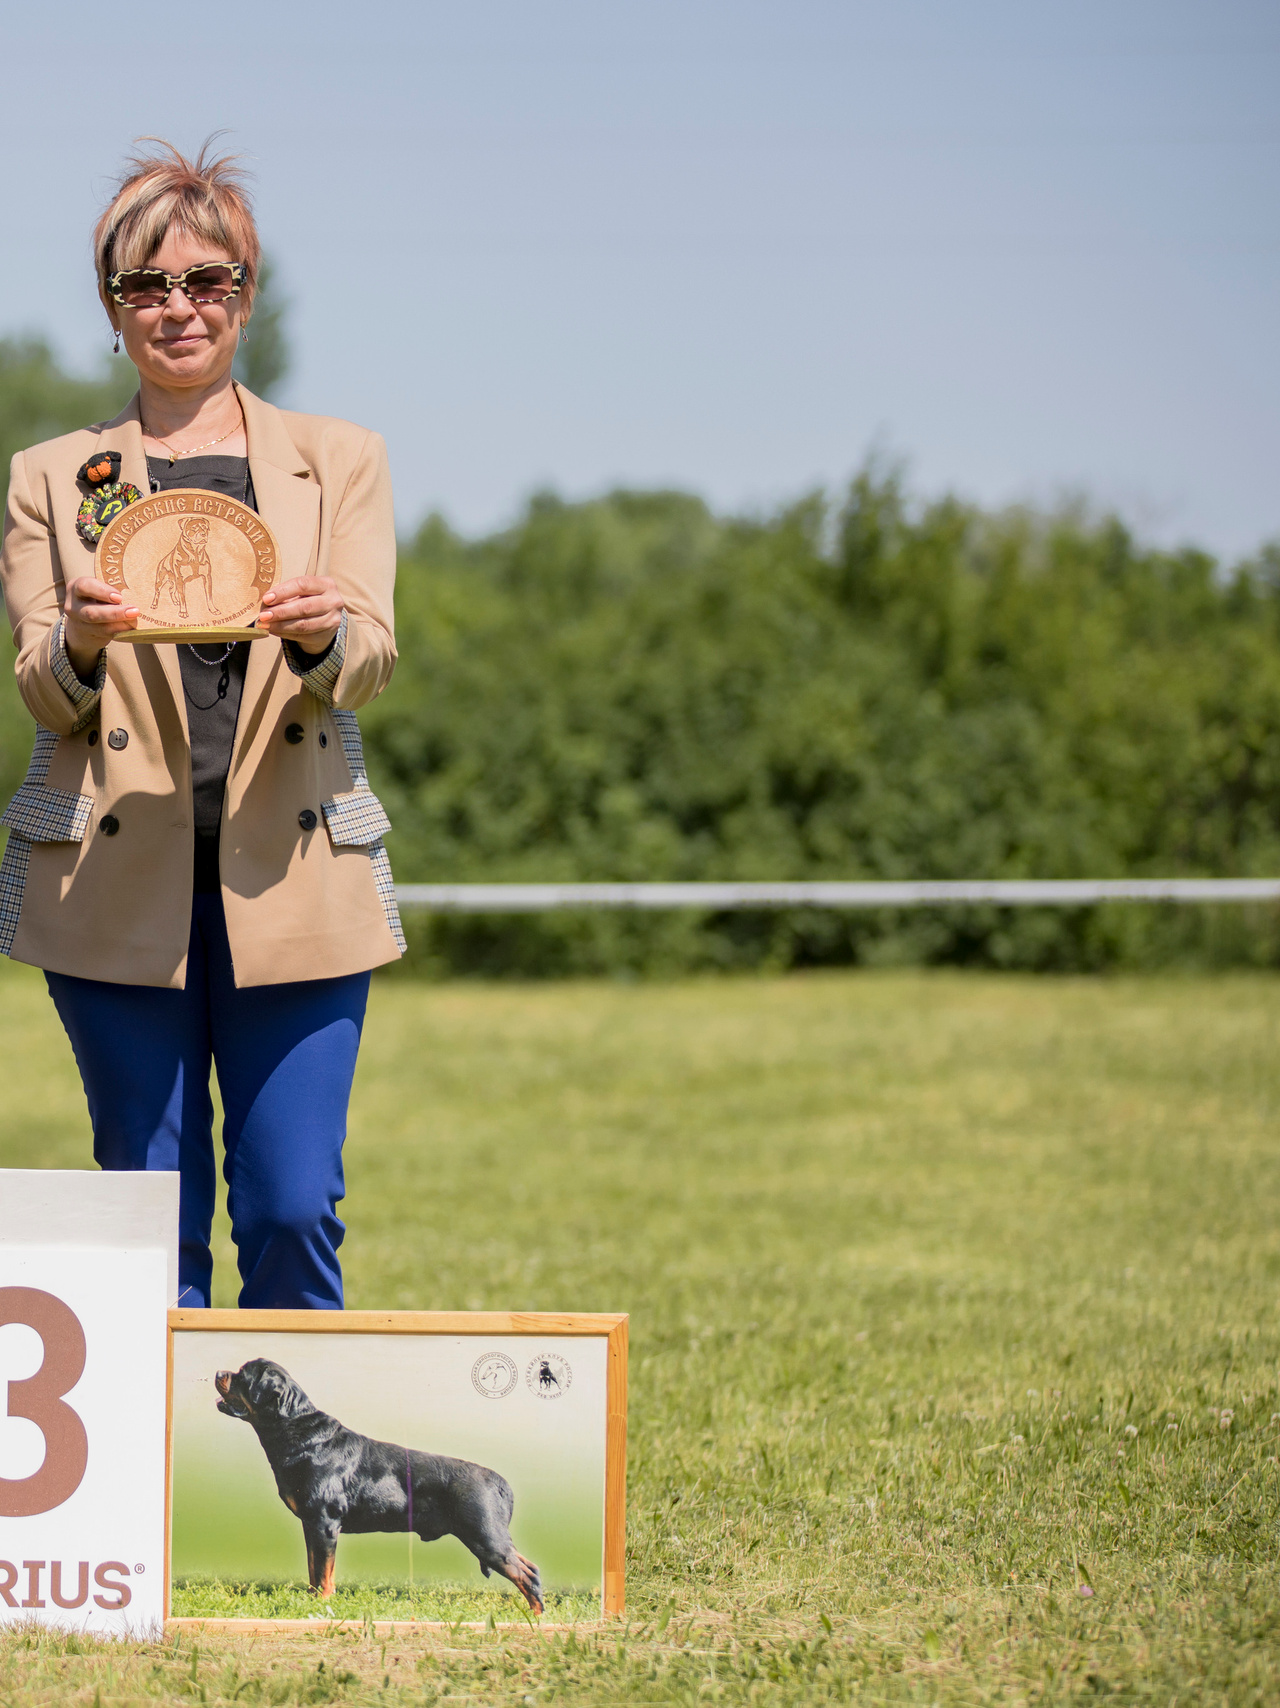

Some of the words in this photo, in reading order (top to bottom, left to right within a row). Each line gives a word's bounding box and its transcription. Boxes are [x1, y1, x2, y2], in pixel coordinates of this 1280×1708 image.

[105, 497, 186, 586] ВОРОНЕЖСКИЕ
[193, 497, 265, 544] ВСТРЕЧИ
[257, 547, 274, 584] 2023
